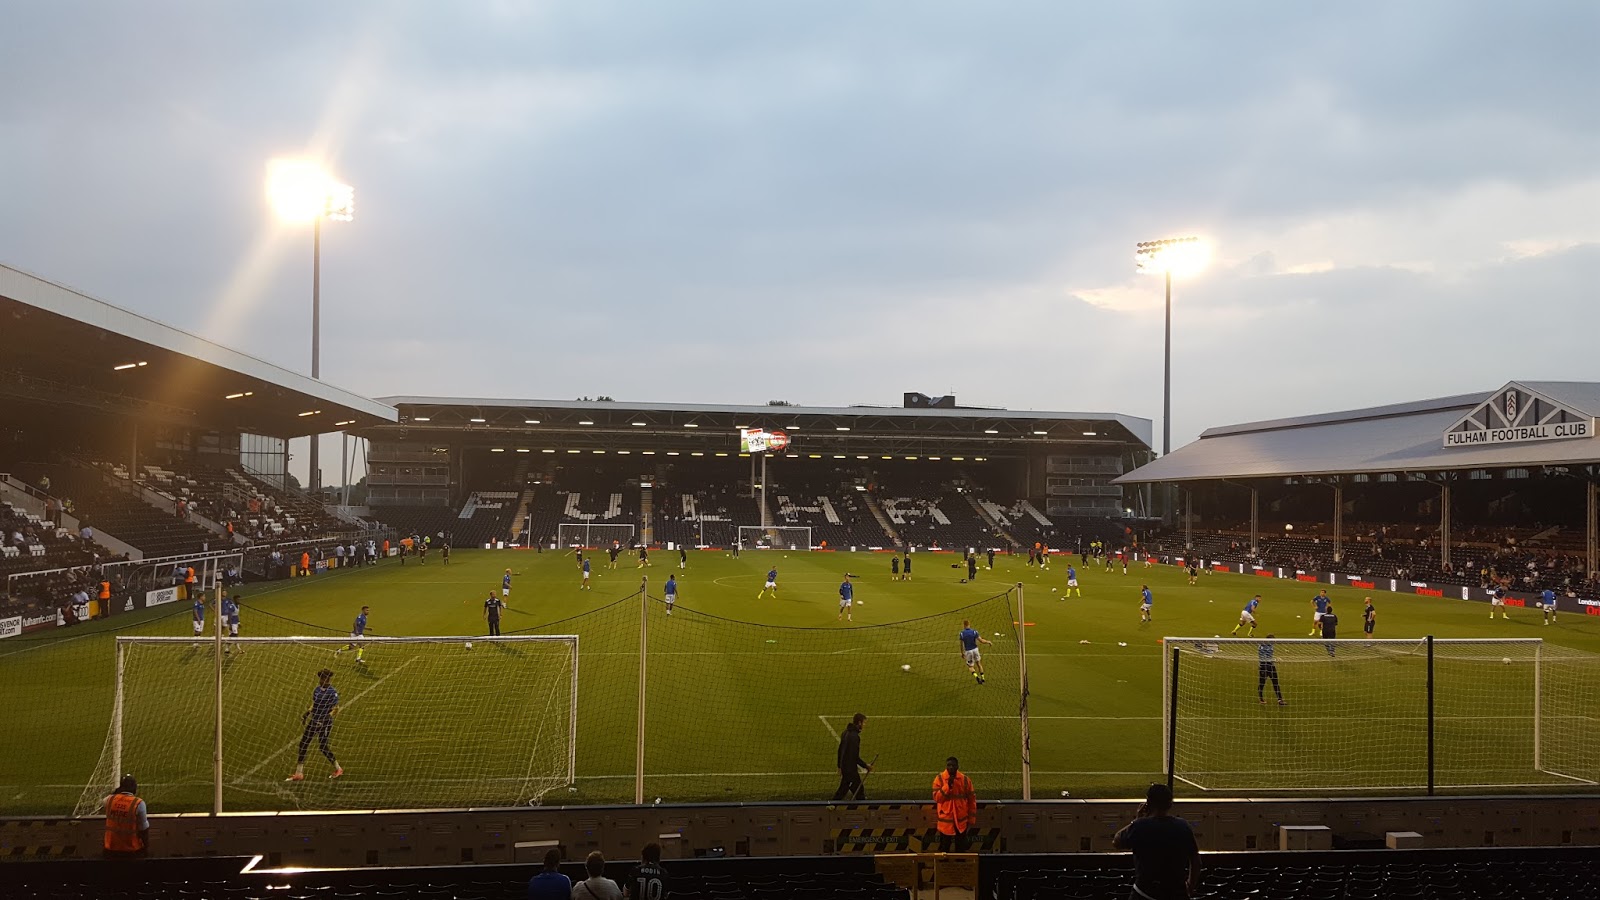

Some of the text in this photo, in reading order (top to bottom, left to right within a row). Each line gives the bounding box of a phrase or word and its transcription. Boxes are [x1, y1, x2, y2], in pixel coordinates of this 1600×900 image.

[1448, 423, 1586, 444] FULHAM FOOTBALL CLUB
[1416, 587, 1443, 598] Original
[637, 877, 662, 900] 10
